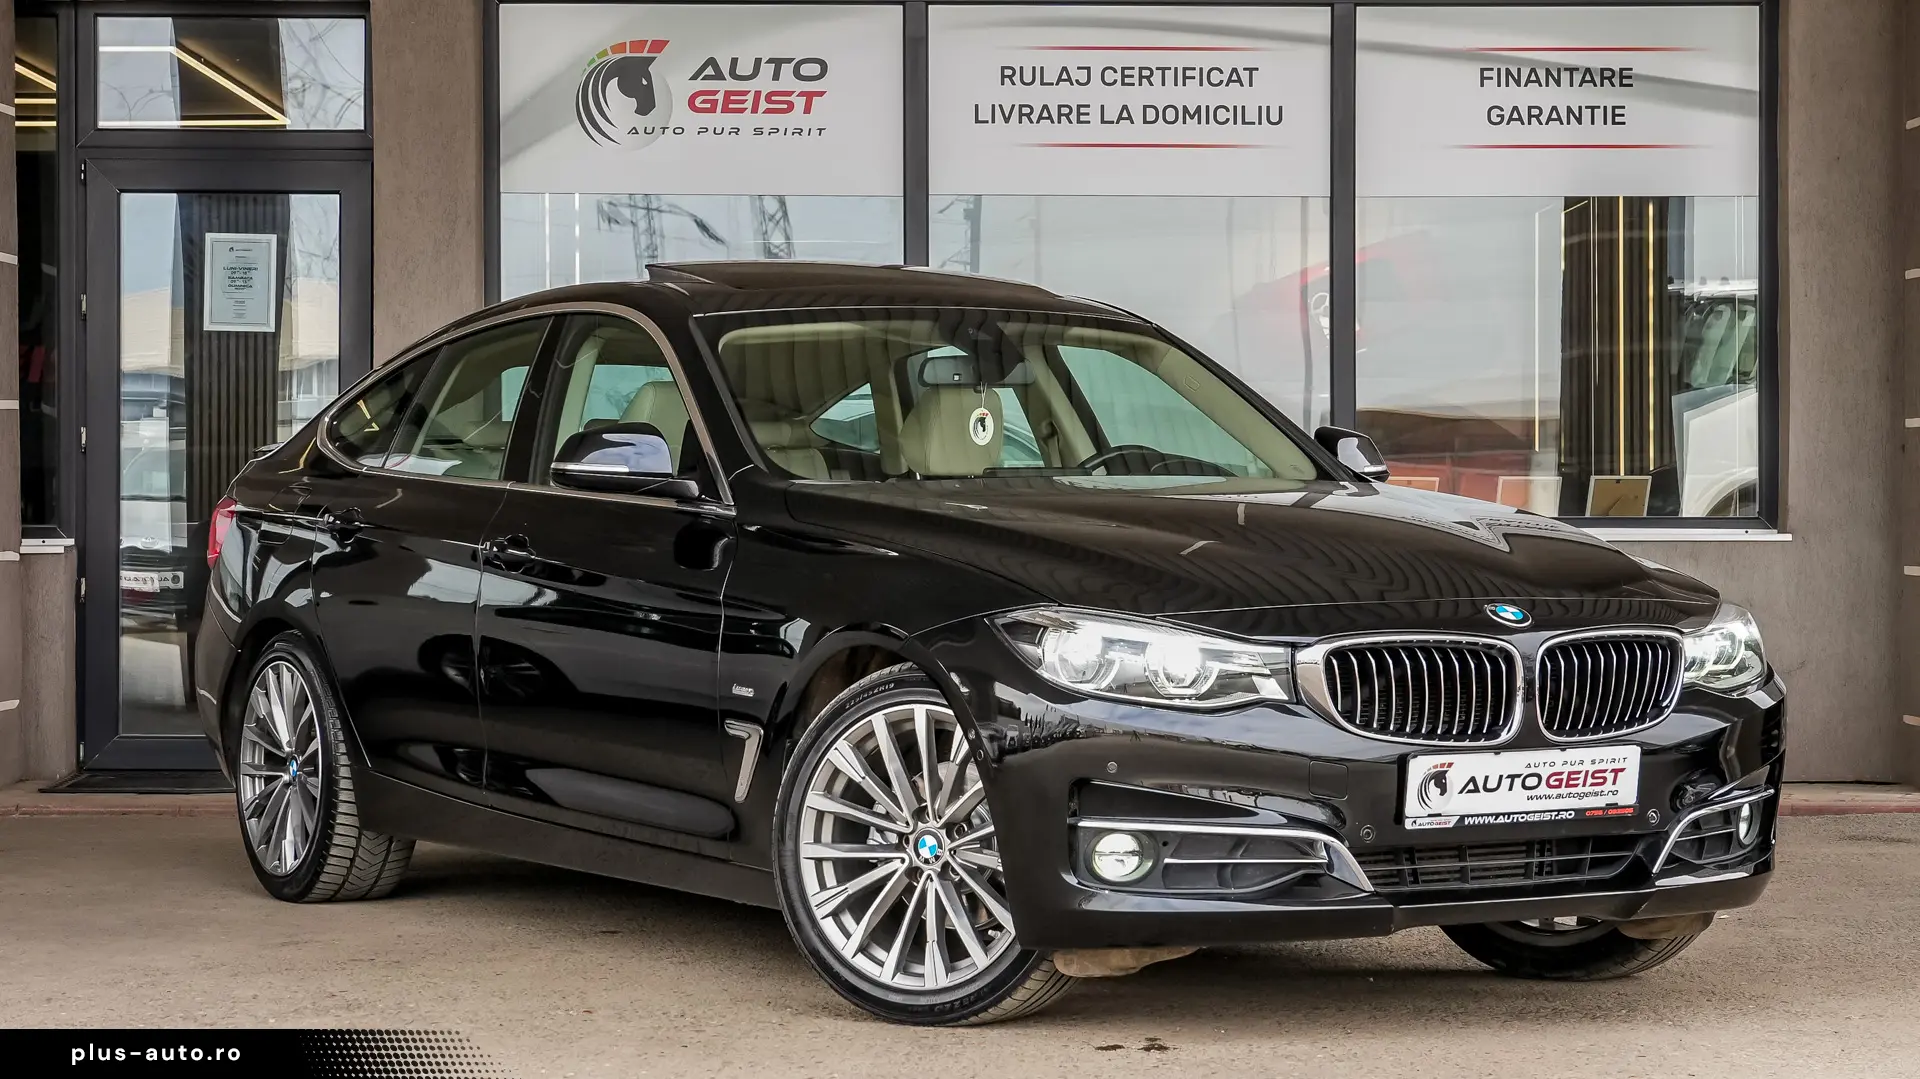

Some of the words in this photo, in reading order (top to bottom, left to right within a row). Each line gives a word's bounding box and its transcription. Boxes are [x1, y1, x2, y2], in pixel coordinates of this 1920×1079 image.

[688, 56, 829, 82] AUTO
[1000, 65, 1093, 87] RULAJ
[1100, 66, 1260, 88] CERTIFICAT
[1479, 67, 1634, 88] FINANTARE
[687, 89, 828, 115] GEIST
[974, 103, 1092, 125] LIVRARE
[1099, 103, 1135, 125] LA
[1142, 104, 1284, 126] DOMICILIU
[1486, 105, 1627, 126] GARANTIE
[626, 126, 686, 136] AUTO
[697, 126, 741, 136] PUR
[752, 127, 827, 137] SPIRIT
[1524, 761, 1556, 769] AUTO
[1561, 759, 1585, 767] PUR
[1590, 757, 1628, 765] SPIRIT
[1526, 789, 1619, 801] www.autogeist.ro
[1464, 810, 1576, 826] WWW.AUTOGEIST.RO
